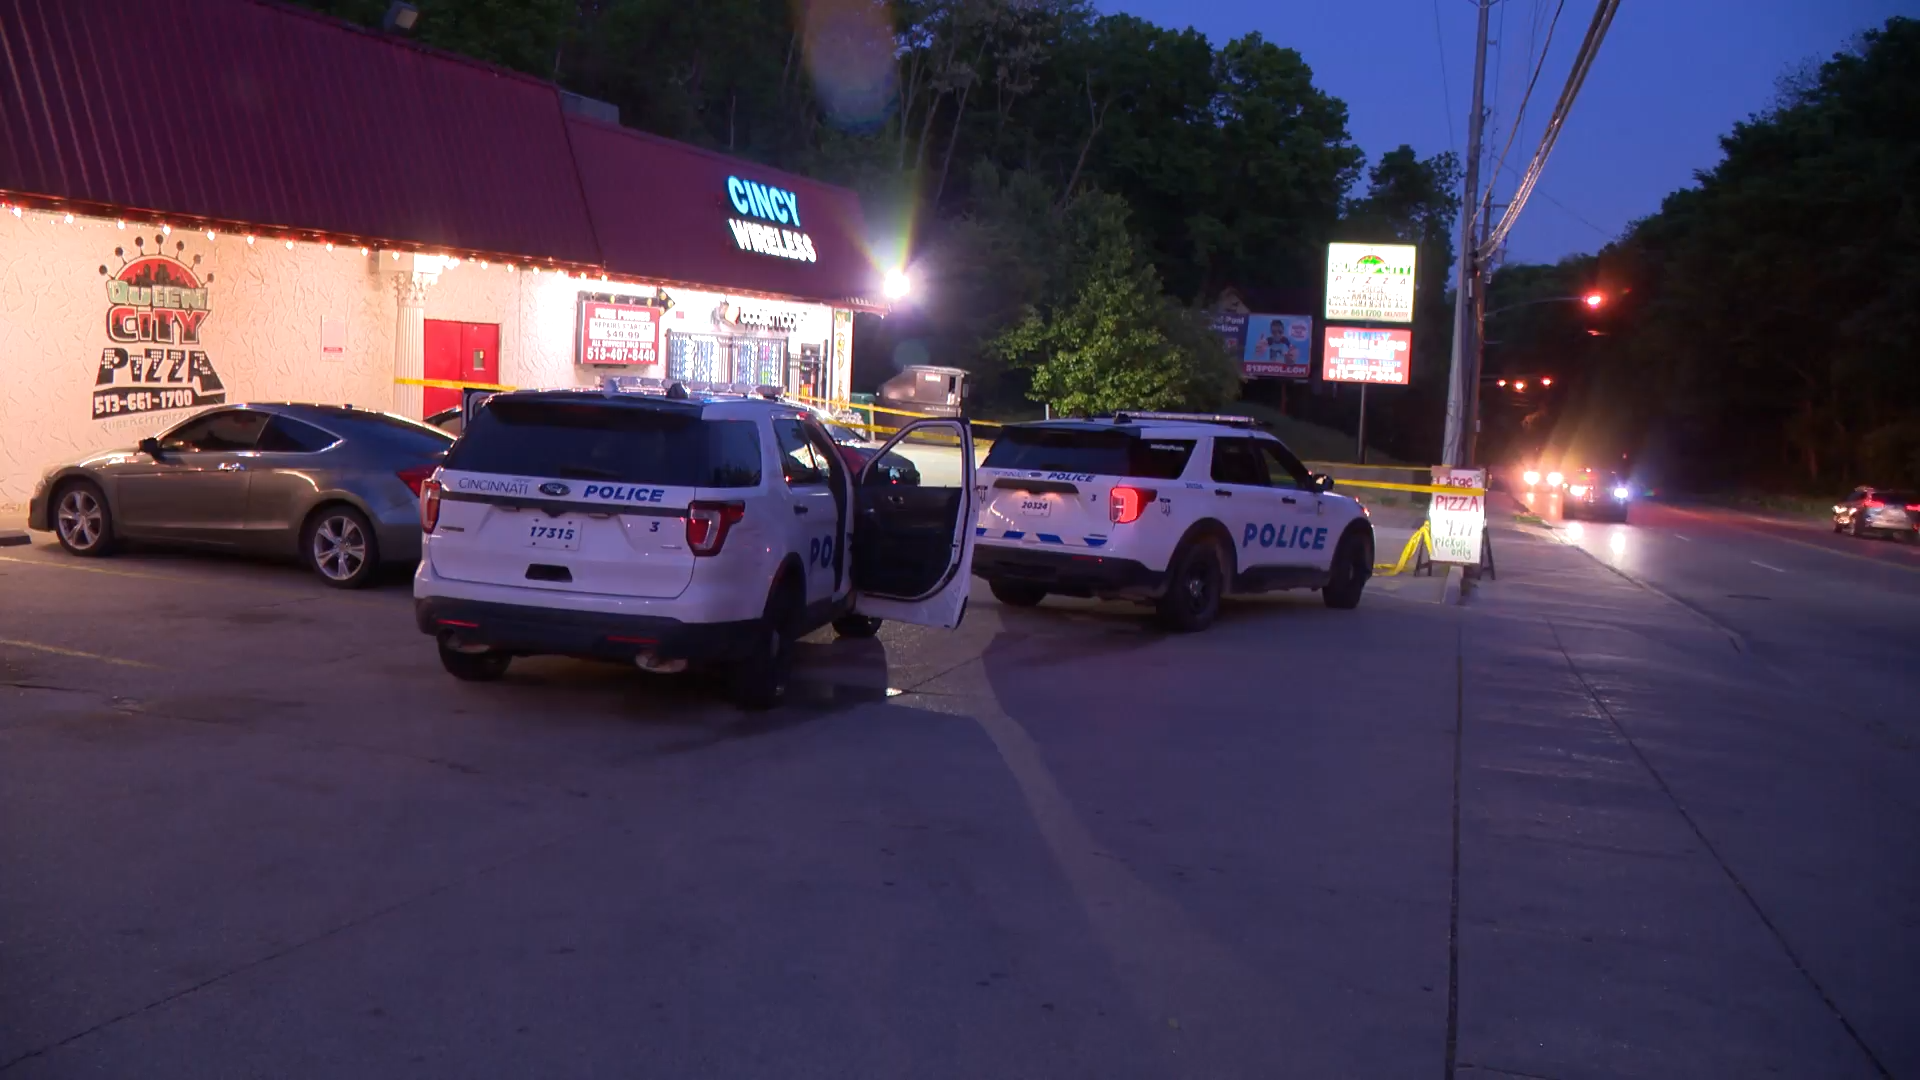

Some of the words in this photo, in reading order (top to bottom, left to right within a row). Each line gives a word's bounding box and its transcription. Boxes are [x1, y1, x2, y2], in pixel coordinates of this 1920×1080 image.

[728, 175, 801, 227] CINCY
[728, 218, 817, 263] WIRELESS
[105, 279, 208, 308] QUEEN
[105, 304, 212, 345] CITY
[587, 347, 656, 361] 513-407-8440
[95, 347, 226, 394] PIZZA
[94, 389, 193, 415] 513-661-1700
[1047, 471, 1096, 483] POLICE
[458, 477, 530, 495] CINCINNATI
[583, 484, 665, 502] POLICE
[1090, 494, 1097, 502] 3
[1021, 501, 1048, 511] 20324
[1435, 495, 1479, 512] PIZZA
[529, 525, 575, 541] 17315
[649, 521, 660, 533] 3
[1242, 523, 1328, 550] POLICE
[1451, 547, 1472, 560] only
